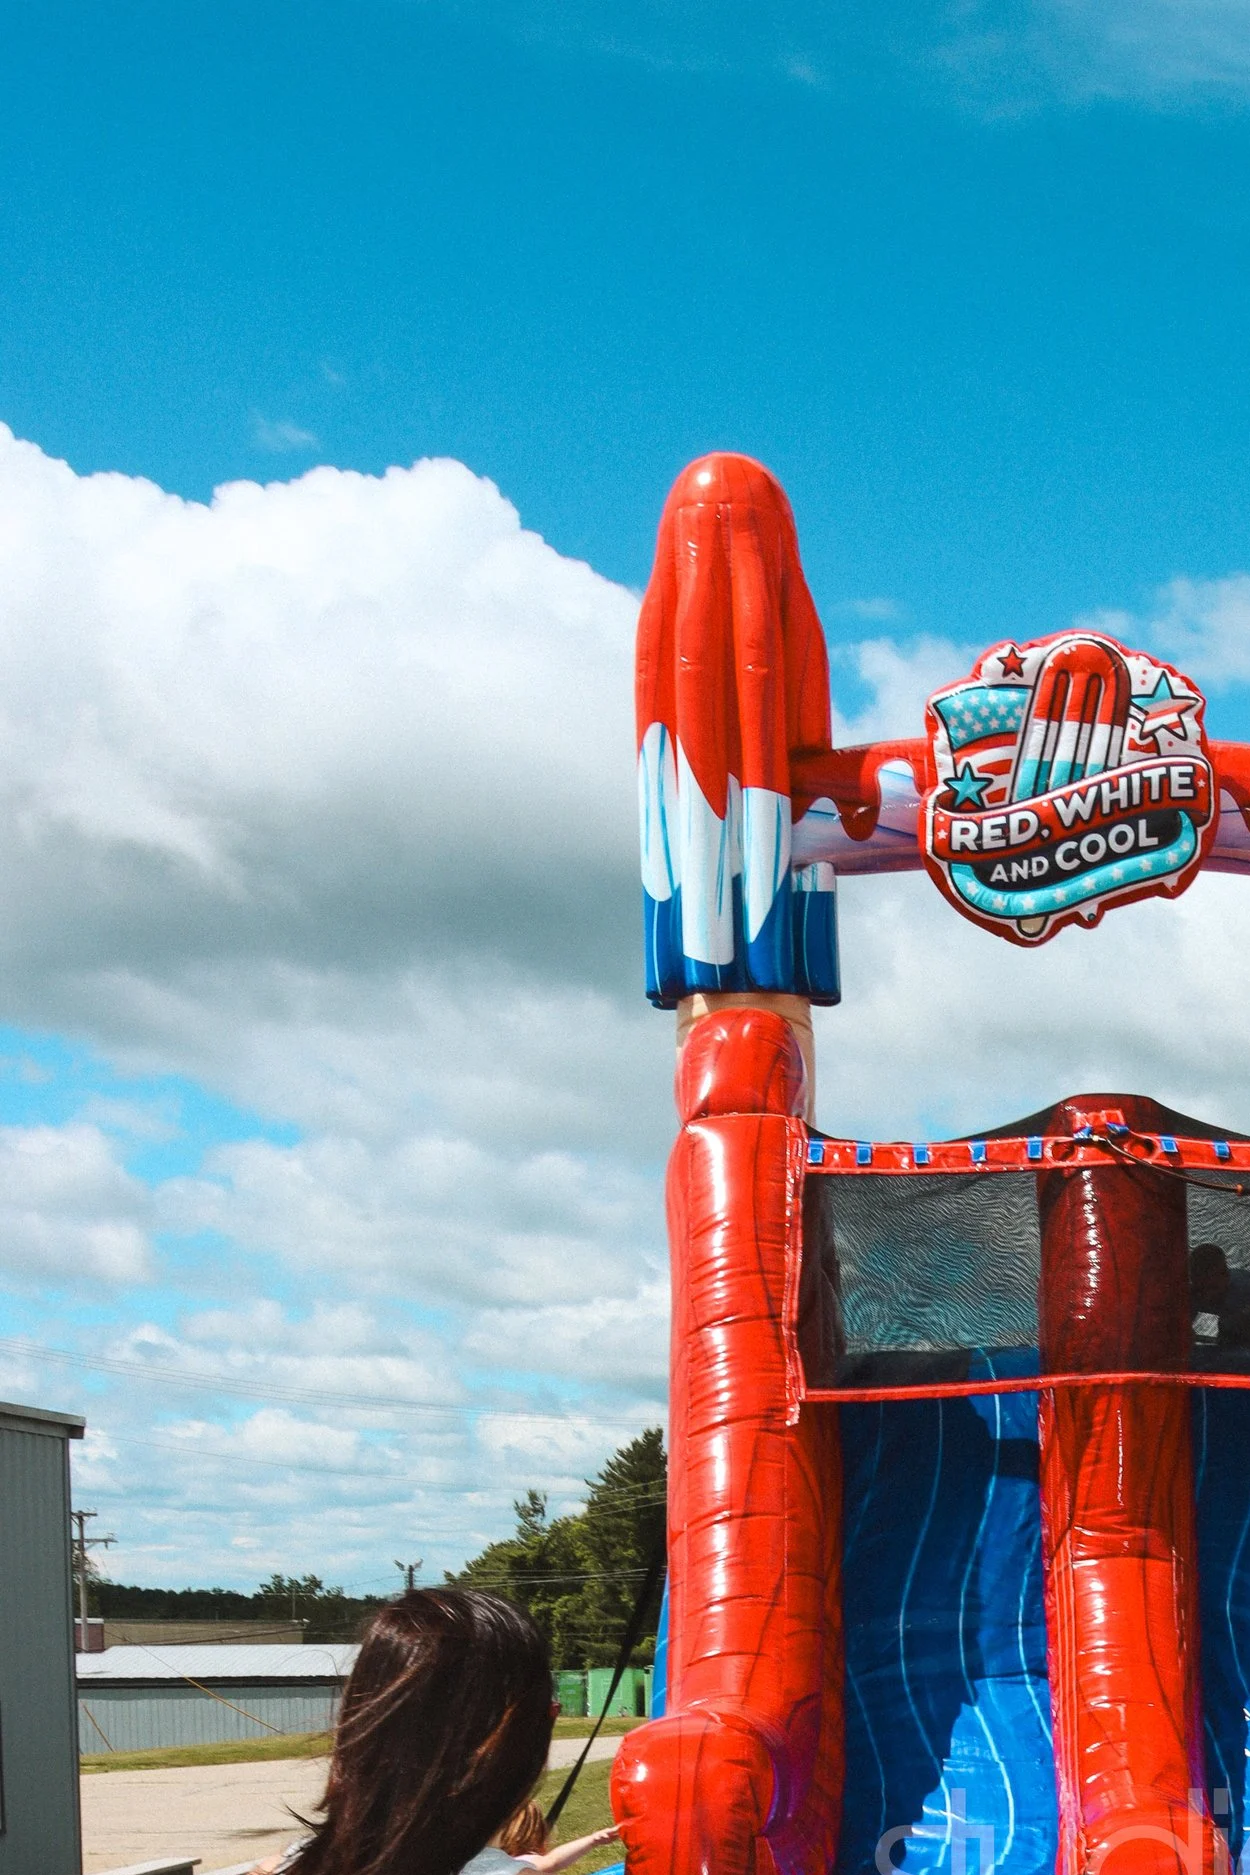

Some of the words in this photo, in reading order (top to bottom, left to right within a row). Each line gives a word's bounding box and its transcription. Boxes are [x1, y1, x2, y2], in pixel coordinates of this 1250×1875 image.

[1053, 765, 1195, 828] WHITE
[990, 862, 1049, 883] AND
[1055, 819, 1158, 871] COOL
